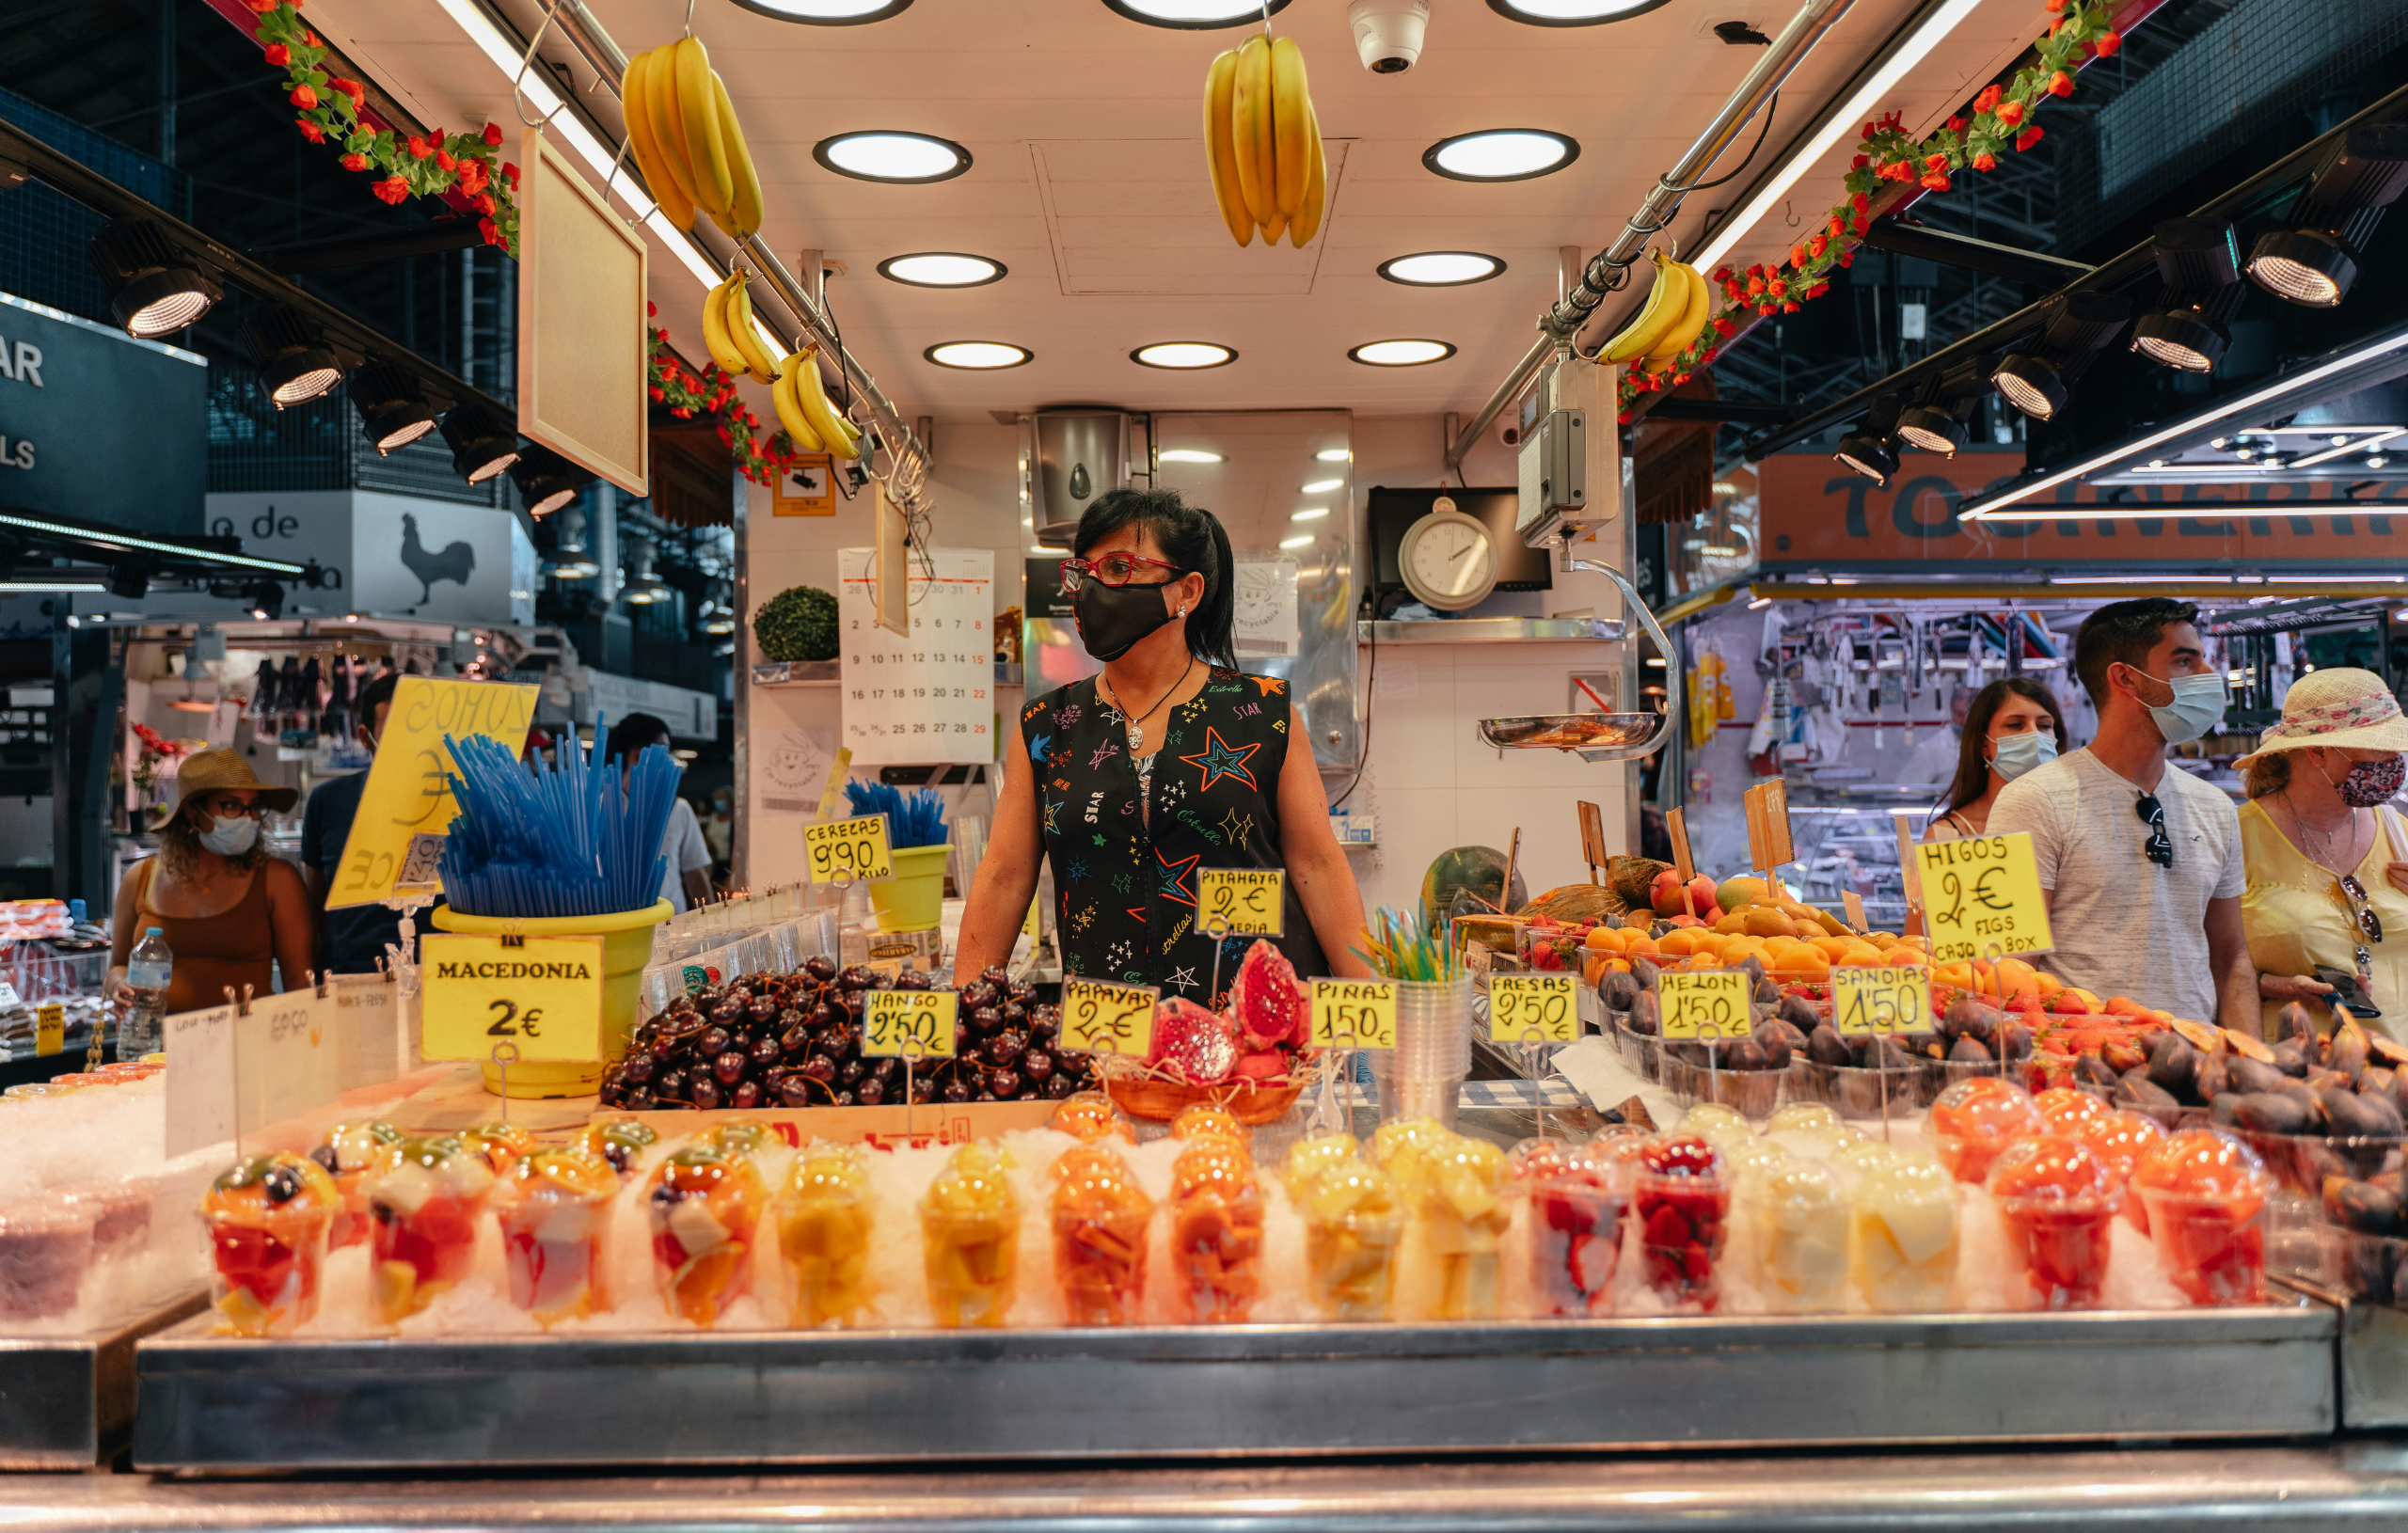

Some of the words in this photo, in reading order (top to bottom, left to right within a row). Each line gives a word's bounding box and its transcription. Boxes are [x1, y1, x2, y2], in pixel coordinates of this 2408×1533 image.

[252, 504, 299, 540] de
[848, 585, 862, 594] 26
[870, 584, 877, 593] 2
[911, 584, 925, 593] 29
[931, 584, 944, 593] 30
[951, 585, 963, 594] 31
[852, 620, 859, 629] 2
[873, 619, 879, 628] 3
[914, 618, 921, 627] 5
[935, 619, 942, 627] 6
[955, 620, 961, 628] 7
[974, 621, 981, 630] 8
[1234, 609, 1279, 628] recyclable
[853, 656, 860, 664] 9
[871, 655, 884, 664] 10
[893, 655, 904, 663] 11
[911, 654, 925, 662] 12
[933, 654, 945, 662] 13
[954, 655, 965, 663] 14
[851, 690, 864, 700] 16
[872, 689, 884, 699] 17
[893, 689, 905, 698] 18
[913, 688, 926, 698] 19
[933, 688, 946, 697] 20
[954, 688, 965, 698] 21
[973, 689, 986, 699] 22
[1233, 703, 1262, 720] STAR
[893, 724, 905, 734] 25
[912, 724, 926, 733] 26
[933, 723, 946, 733] 27
[954, 724, 967, 733] 28
[974, 725, 986, 734] 29
[1085, 791, 1105, 824] STAR
[806, 818, 880, 841] CEREZAS
[1925, 836, 2007, 870] HIGOS
[1202, 872, 1278, 885] PITAHAYA
[1975, 915, 2015, 936] FIGS
[2004, 936, 2037, 952] BOX
[437, 962, 592, 979] MACEDONIA
[1836, 967, 1928, 986] SANDIAS
[1492, 977, 1571, 993] FRESAS
[1068, 981, 1153, 1012] PAPAYAS
